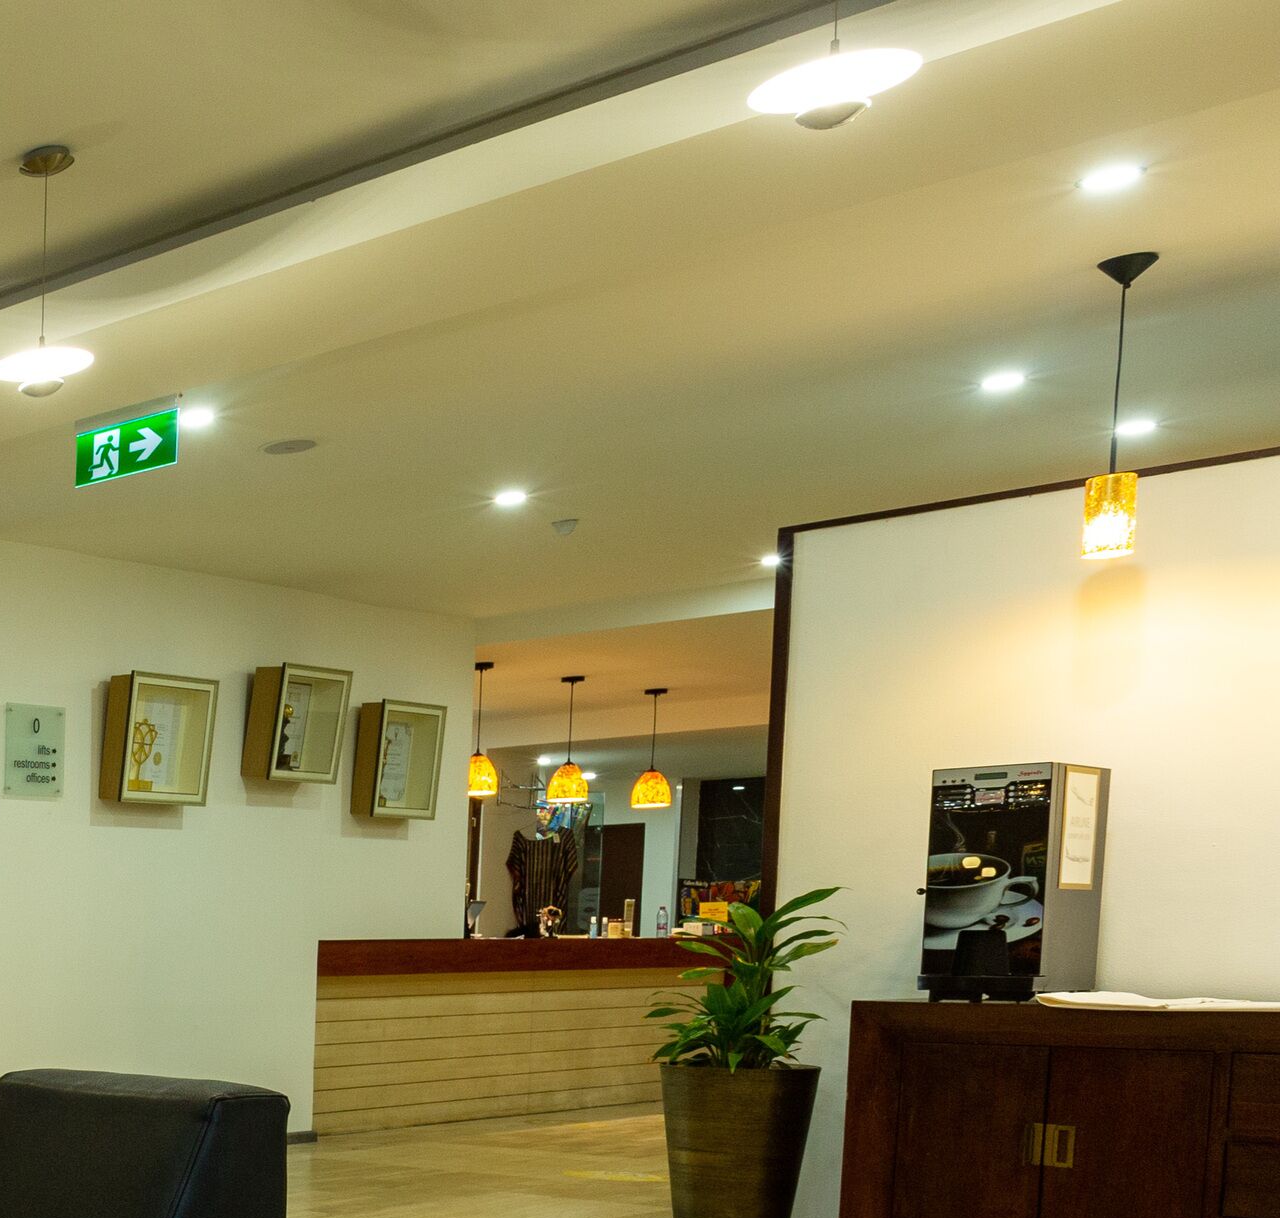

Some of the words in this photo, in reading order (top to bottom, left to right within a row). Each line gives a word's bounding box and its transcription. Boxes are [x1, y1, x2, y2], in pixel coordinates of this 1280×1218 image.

[37, 745, 51, 755] lifts
[13, 759, 51, 769] restrooms
[26, 773, 50, 783] offices
